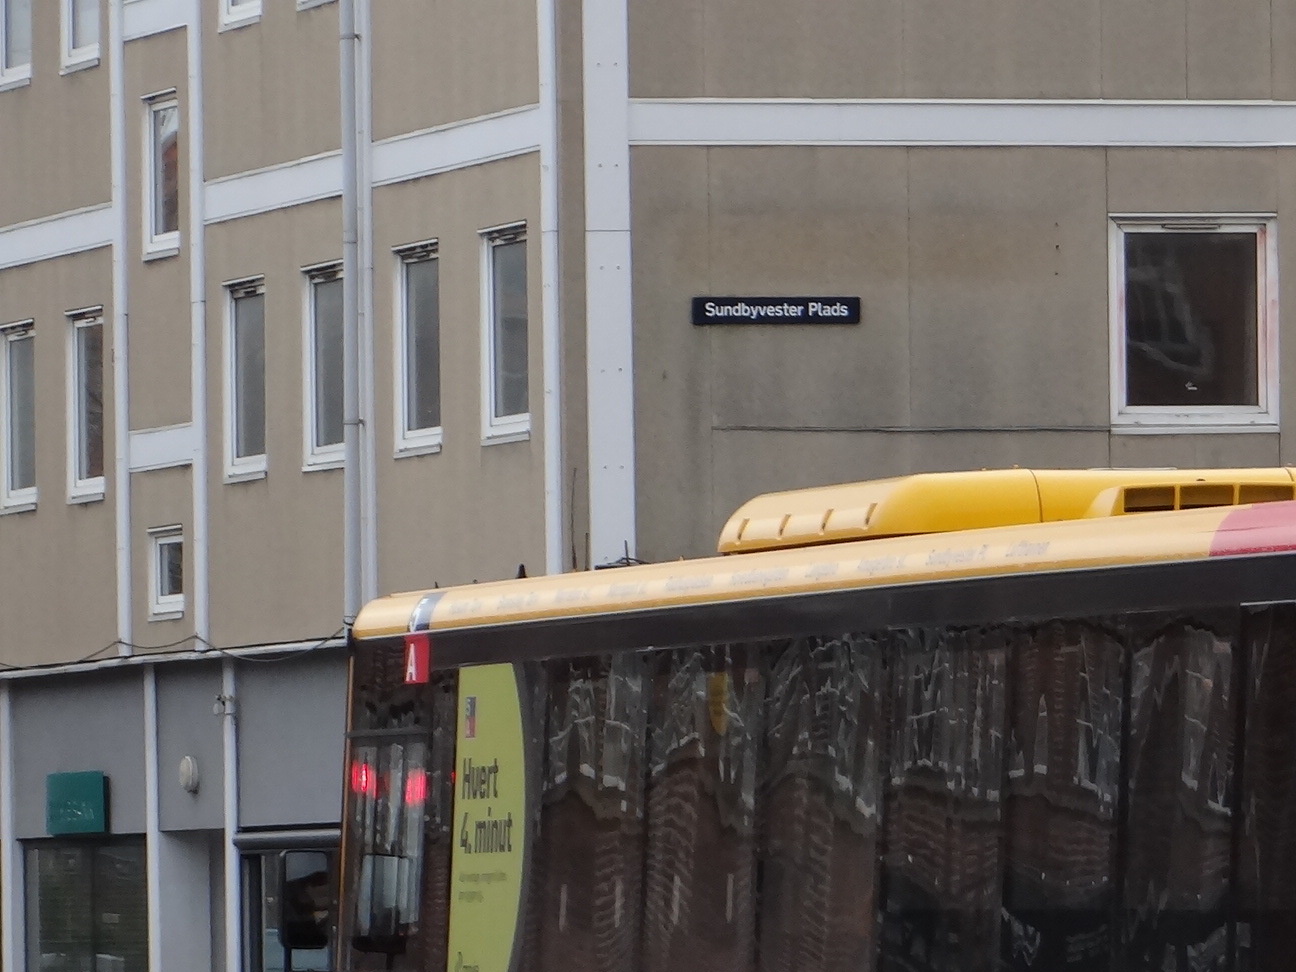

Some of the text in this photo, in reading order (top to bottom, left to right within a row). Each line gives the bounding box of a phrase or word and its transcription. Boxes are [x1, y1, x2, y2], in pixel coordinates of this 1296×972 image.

[705, 302, 848, 319] Sundbyvester Plads
[474, 807, 513, 853] minut
